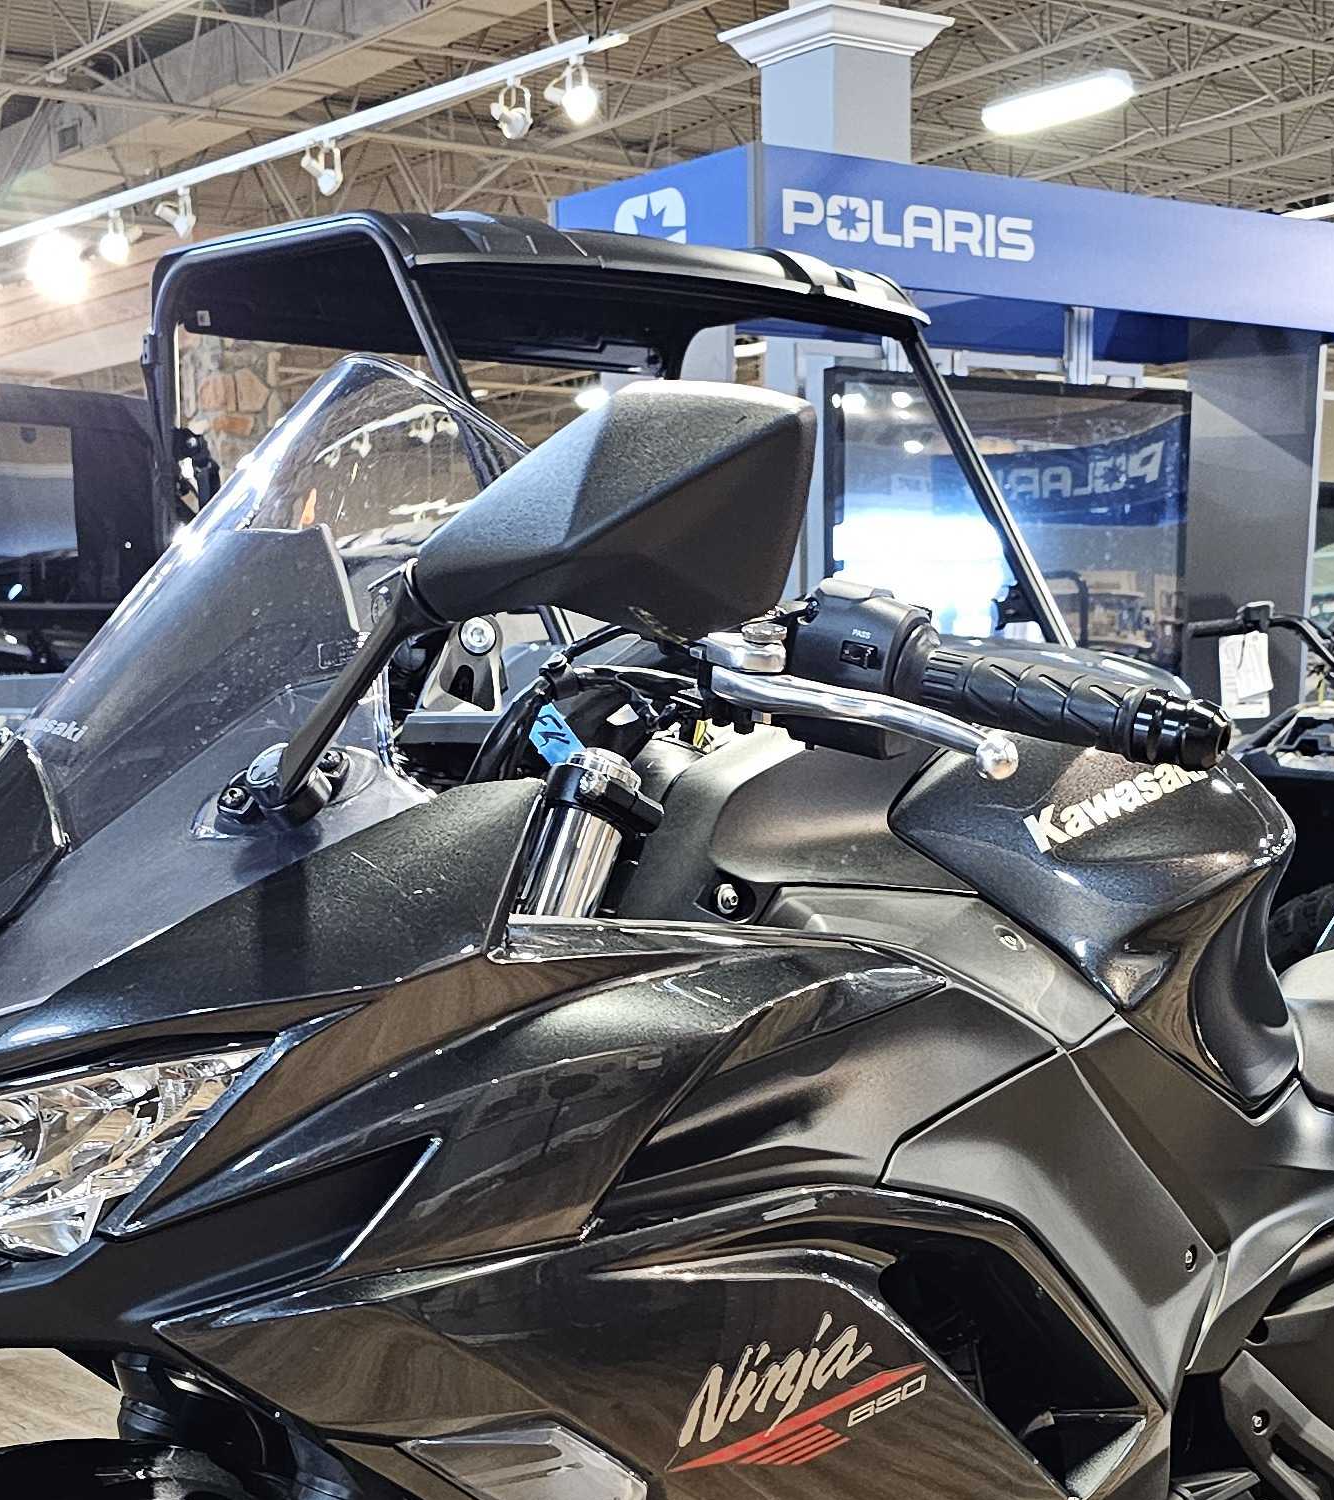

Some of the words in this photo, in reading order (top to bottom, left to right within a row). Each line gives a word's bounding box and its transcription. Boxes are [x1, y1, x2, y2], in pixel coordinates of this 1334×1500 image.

[782, 188, 1035, 262] POLARIS
[852, 628, 872, 639] PASS
[1022, 763, 1209, 853] Kawasaki
[665, 1311, 872, 1469] Ninja
[847, 1375, 927, 1427] 650
